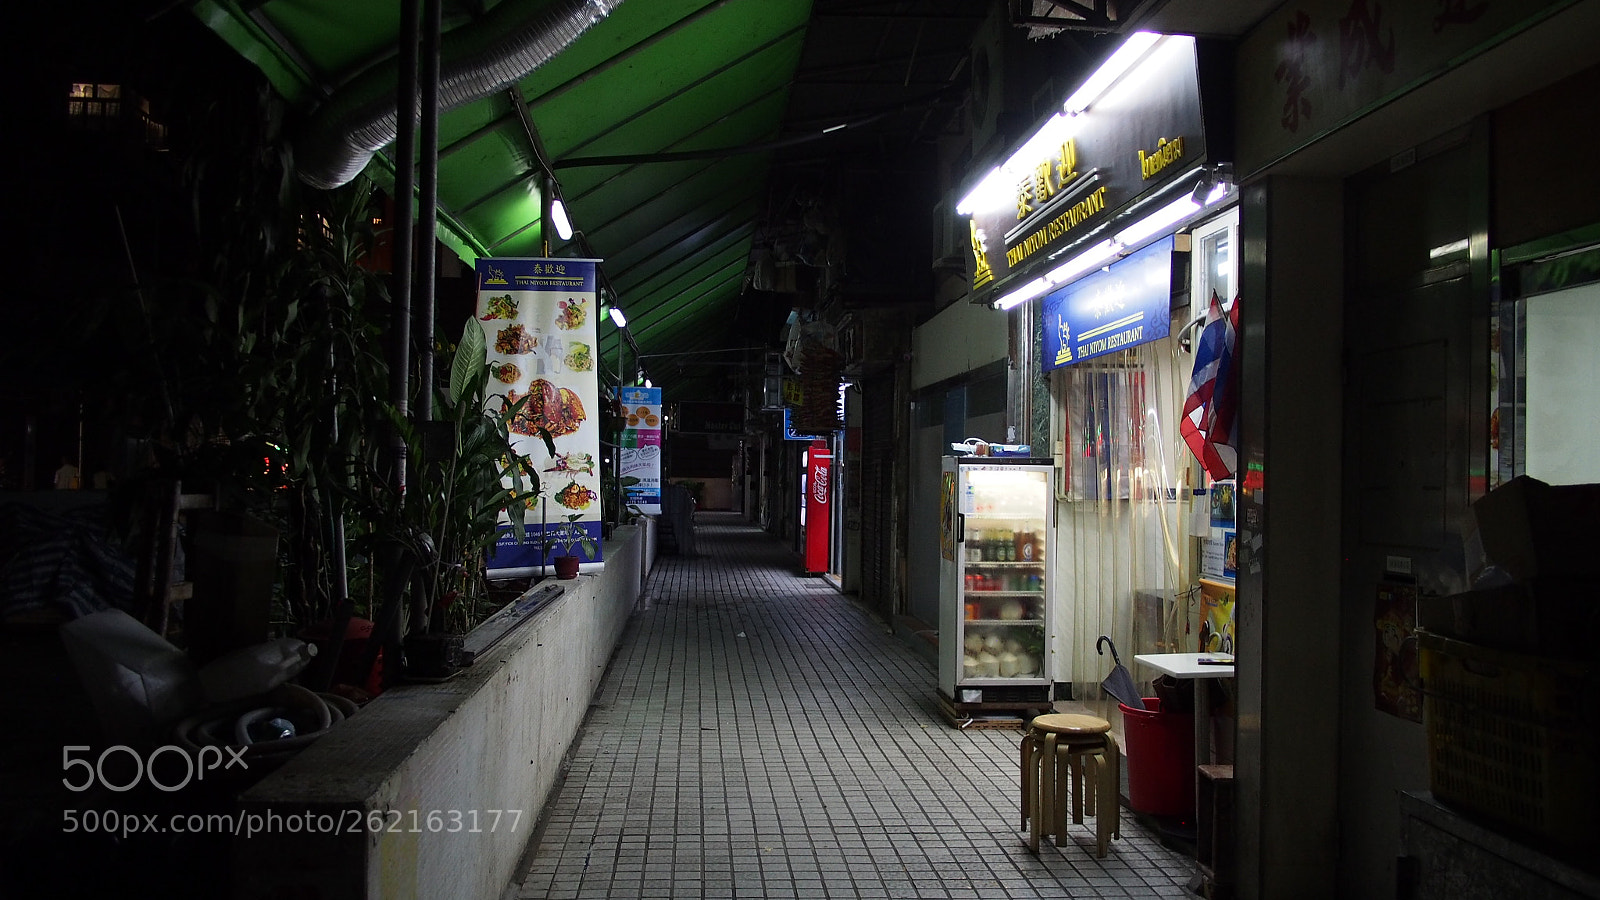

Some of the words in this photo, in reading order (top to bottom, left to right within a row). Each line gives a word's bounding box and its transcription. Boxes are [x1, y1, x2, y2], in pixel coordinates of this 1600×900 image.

[1006, 243, 1023, 268] THAI
[1023, 226, 1048, 257] NIYOM
[1047, 186, 1106, 242] RESTAURANT
[1077, 344, 1089, 359] THAI
[1090, 338, 1107, 355] NIYOM
[1107, 326, 1144, 350] RESTAURANT
[814, 464, 828, 504] Coca-Cola
